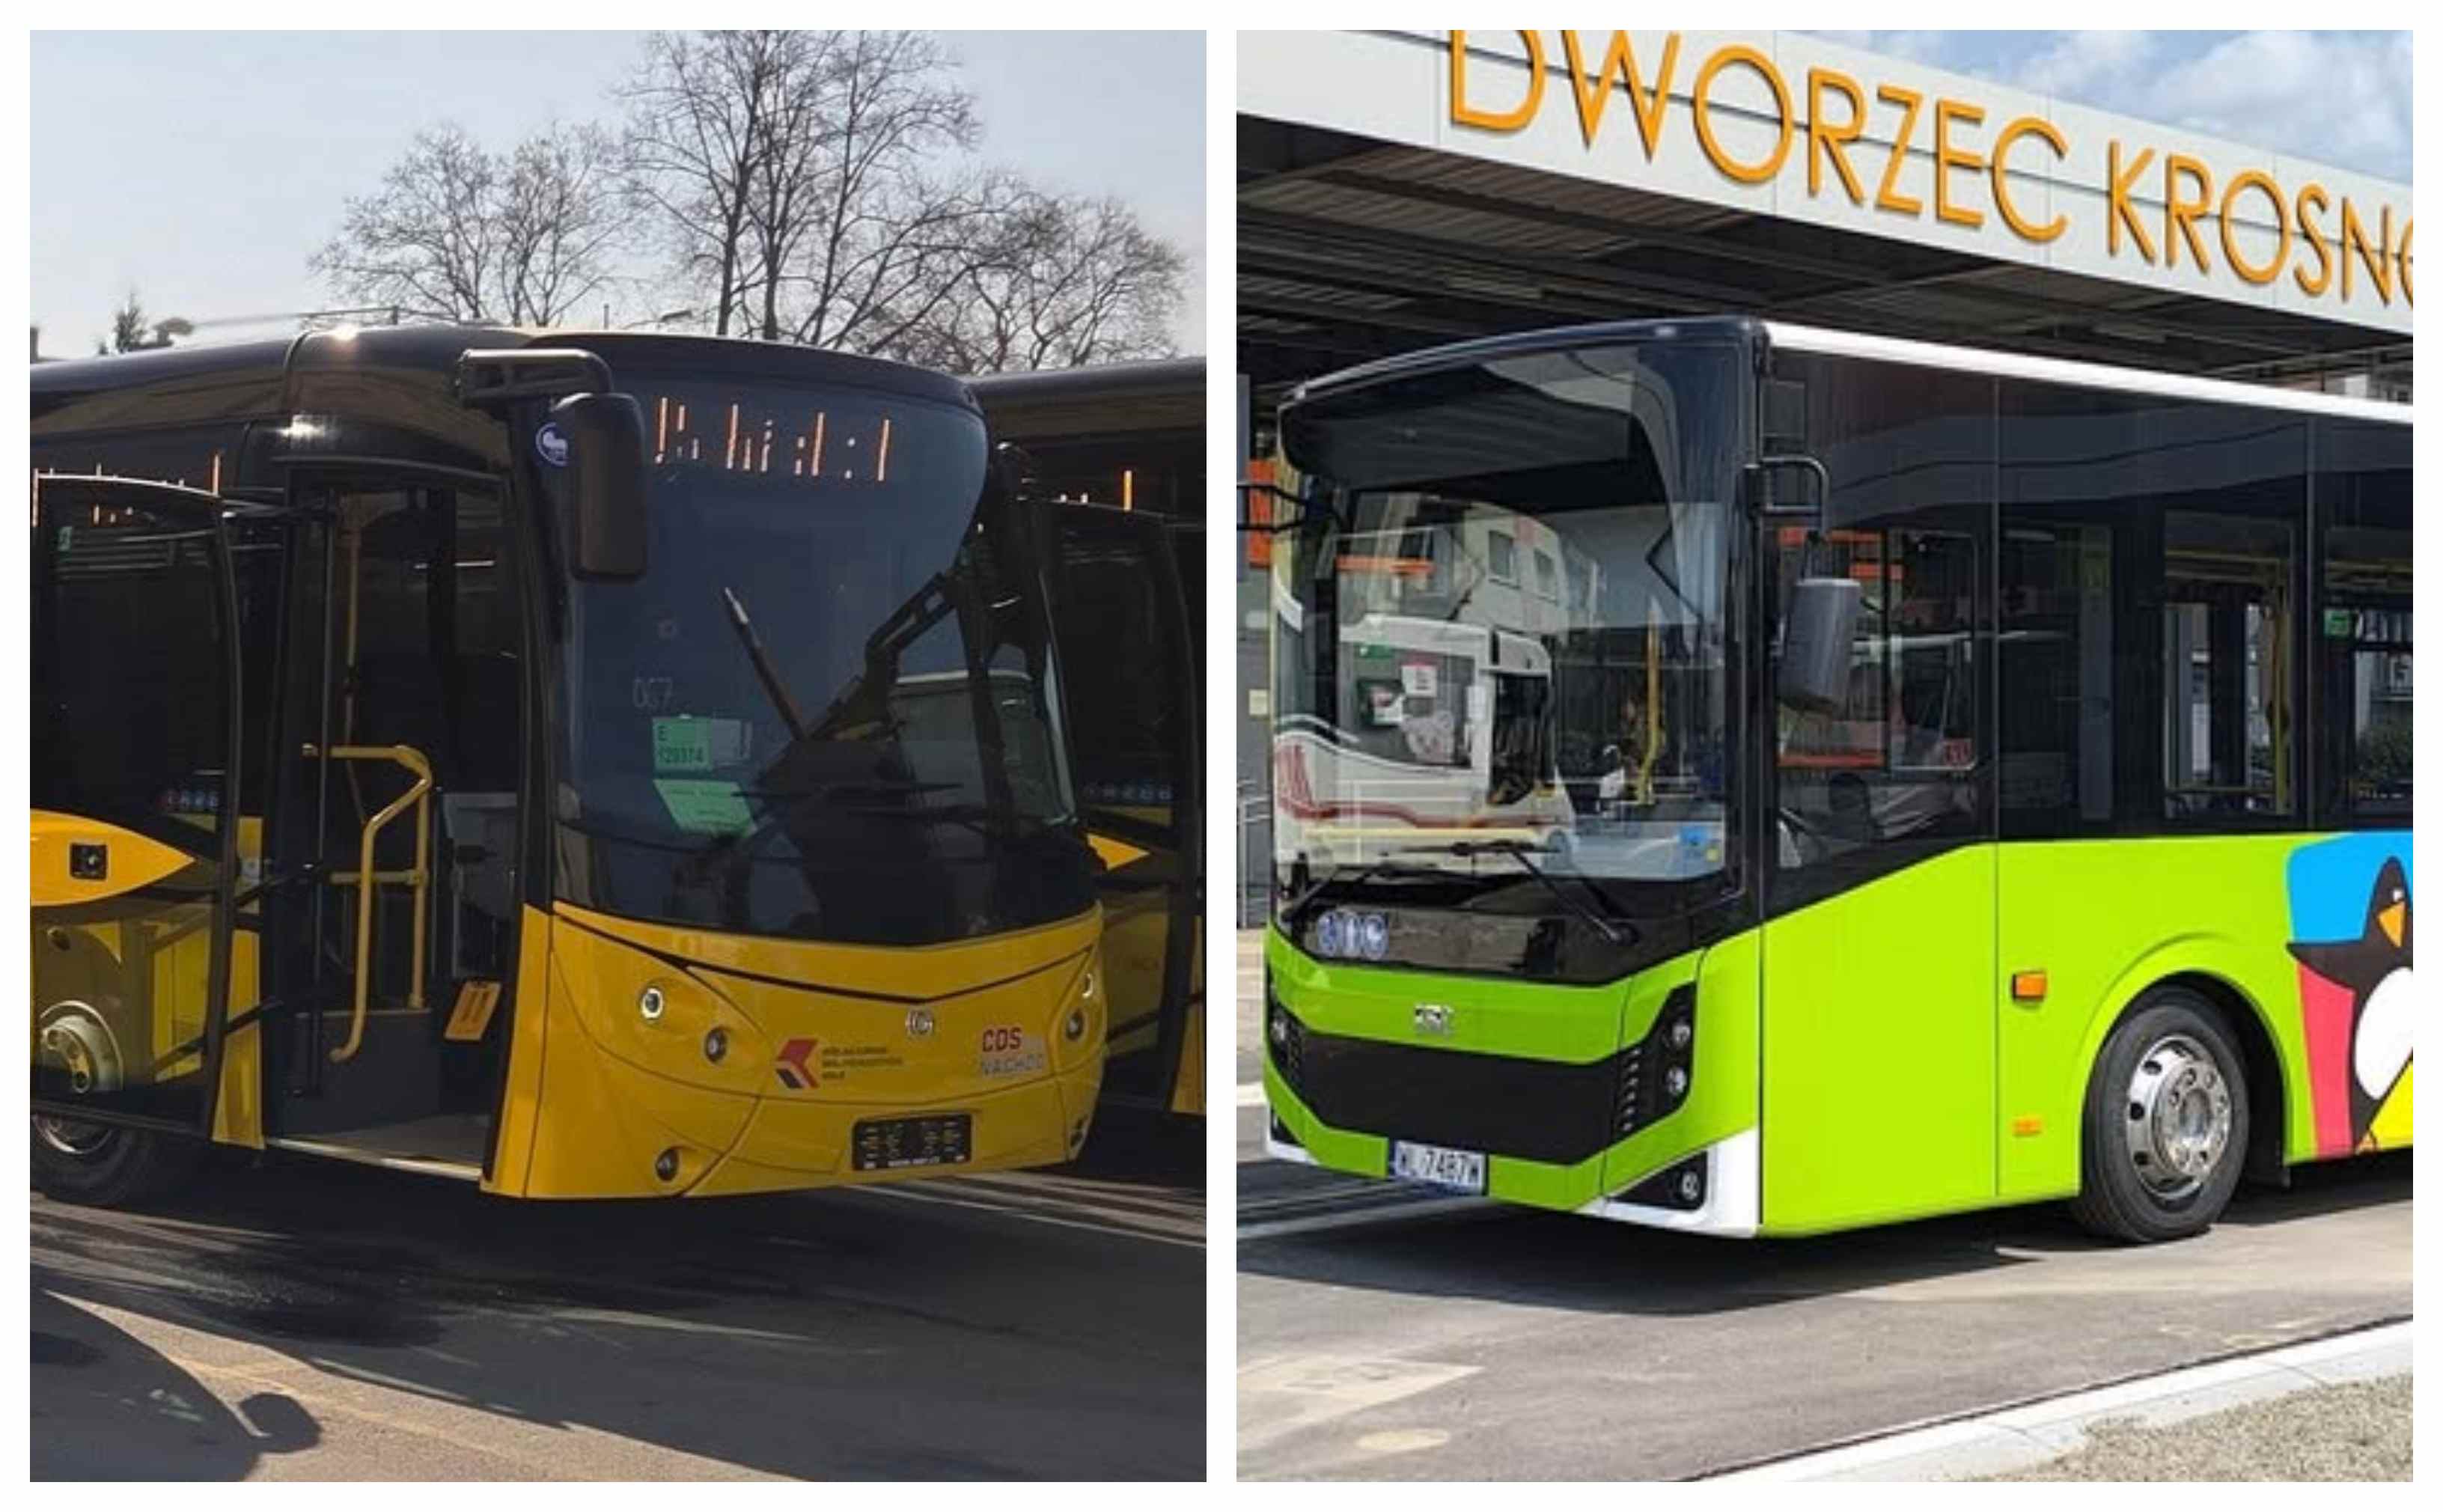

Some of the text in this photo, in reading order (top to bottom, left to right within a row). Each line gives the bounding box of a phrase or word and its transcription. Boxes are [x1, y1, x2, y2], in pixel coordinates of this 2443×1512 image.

[1451, 29, 2414, 309] DWORZEC KROSN
[982, 1026, 1022, 1052] CDS
